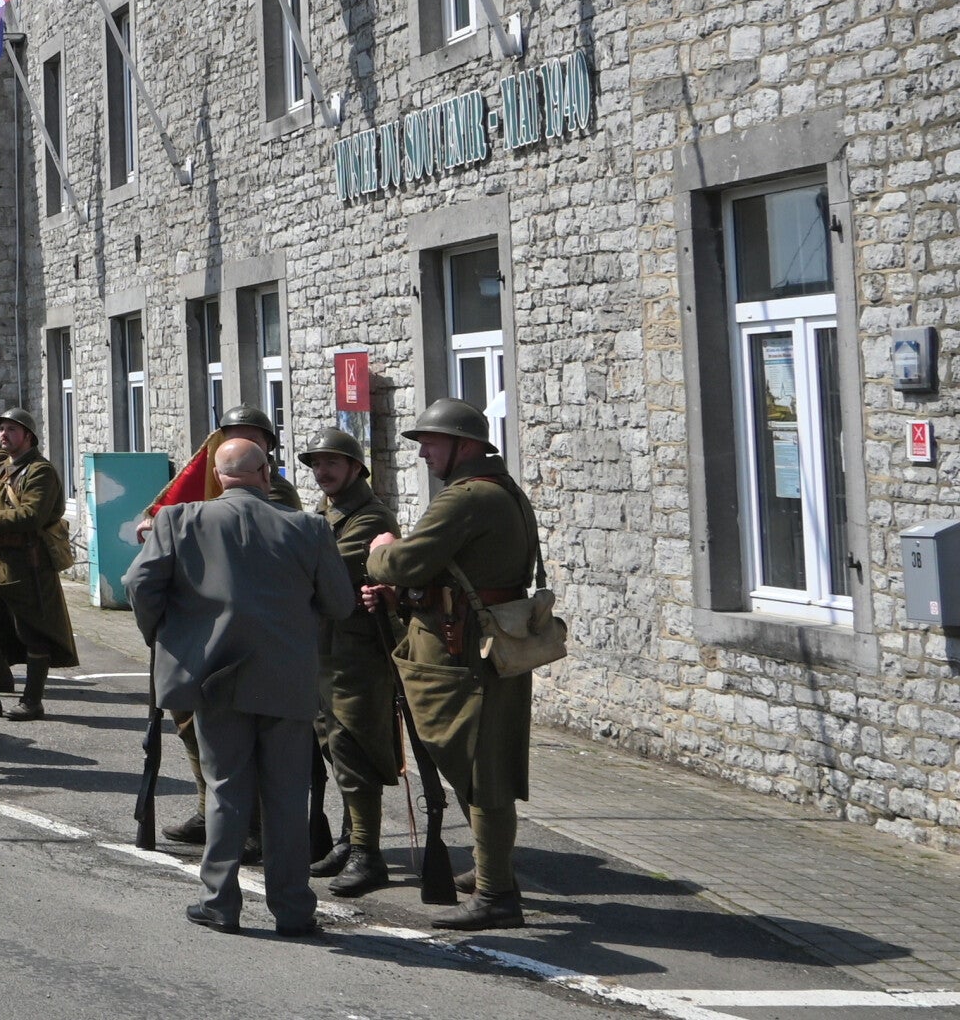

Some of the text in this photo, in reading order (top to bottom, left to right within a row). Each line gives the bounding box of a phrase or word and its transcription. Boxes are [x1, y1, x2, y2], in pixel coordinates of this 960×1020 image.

[380, 119, 401, 189] DU
[404, 89, 487, 182] SOUVENIR
[501, 68, 539, 151] MAI
[541, 48, 591, 139] 1940
